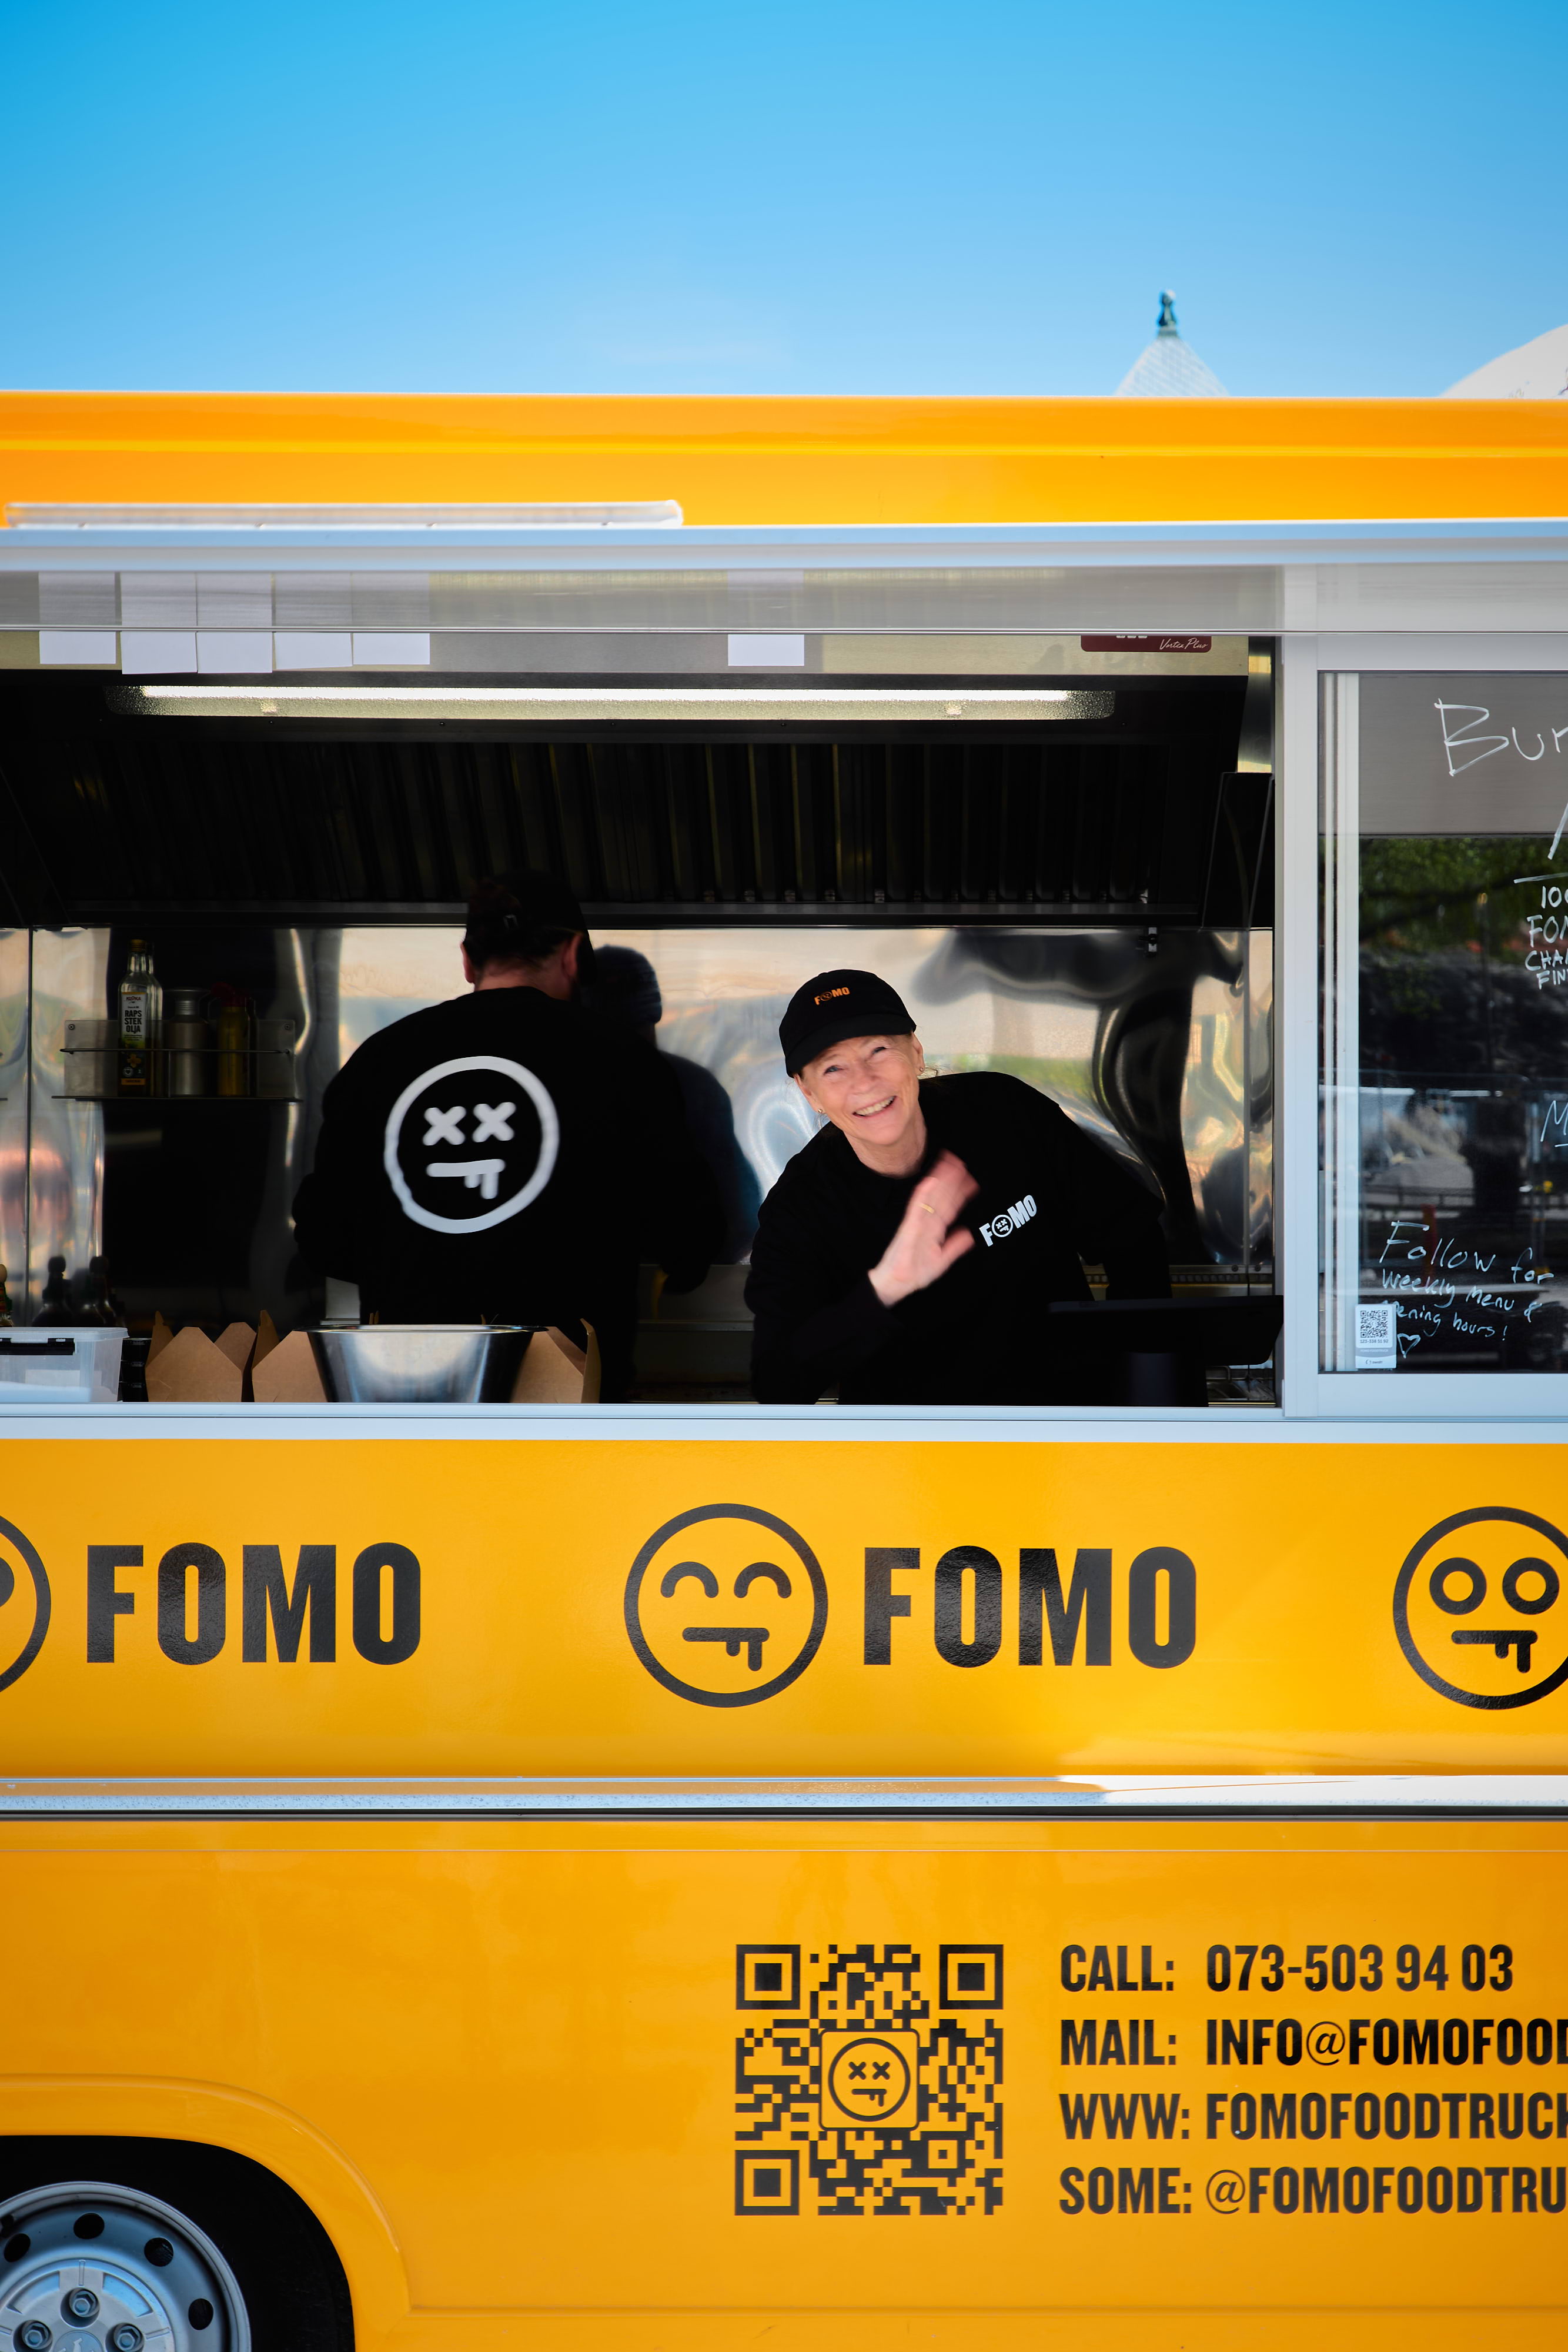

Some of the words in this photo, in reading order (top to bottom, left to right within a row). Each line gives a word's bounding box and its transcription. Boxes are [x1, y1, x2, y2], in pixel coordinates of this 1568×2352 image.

[1542, 886, 1568, 909] 10
[1525, 949, 1568, 971] CHA
[1536, 969, 1568, 990] FIN
[126, 1025, 141, 1034] OLJA
[1379, 1220, 1496, 1272] Follow
[1511, 1247, 1554, 1284] for
[1382, 1299, 1441, 1337] ening
[87, 1542, 421, 1665] FOMO
[864, 1545, 1196, 1669] FOMO
[1060, 1945, 1175, 1992] CALL:
[1207, 1944, 1383, 1992] 073-503
[1396, 1944, 1449, 1992] 94
[1461, 1944, 1513, 1992] 03
[1061, 2019, 1176, 2066] MAIL:
[1059, 2093, 1190, 2139] WWW:
[1059, 2167, 1192, 2214] SOME:
[1206, 2166, 1567, 2214] @FOMOFOODTRU
